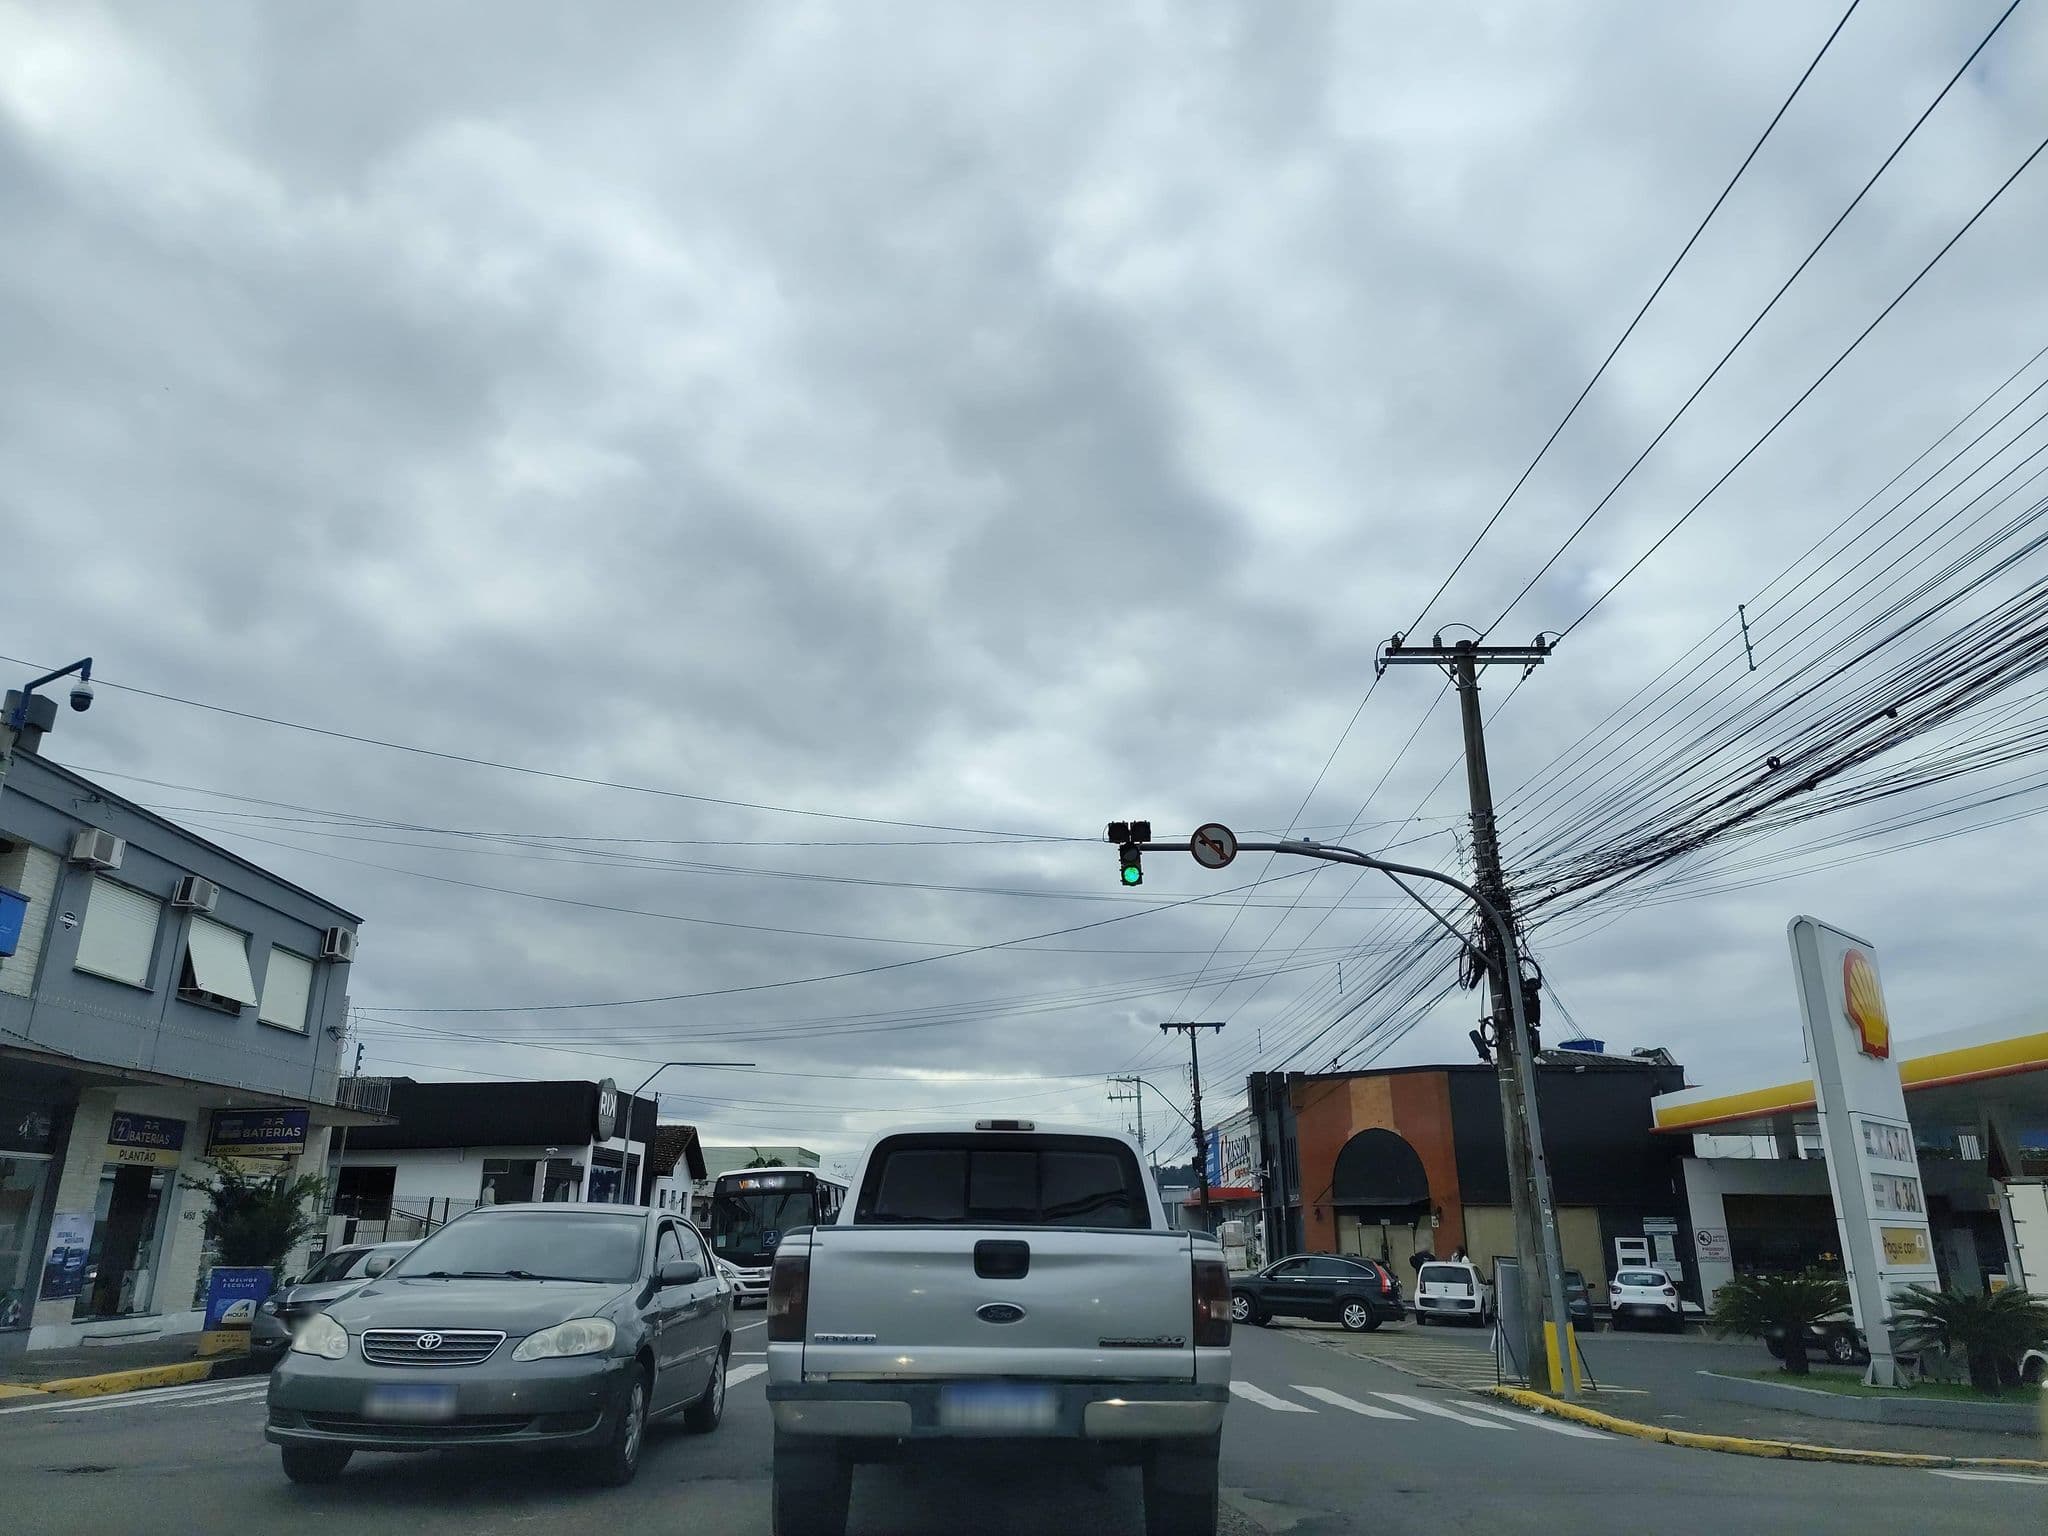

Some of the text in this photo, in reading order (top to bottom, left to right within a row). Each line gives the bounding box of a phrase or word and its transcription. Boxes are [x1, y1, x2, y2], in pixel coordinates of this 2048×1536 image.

[129, 1130, 170, 1145] BATERIAS
[242, 1127, 301, 1138] BATERIAS
[119, 1148, 157, 1162] PLANTÃO
